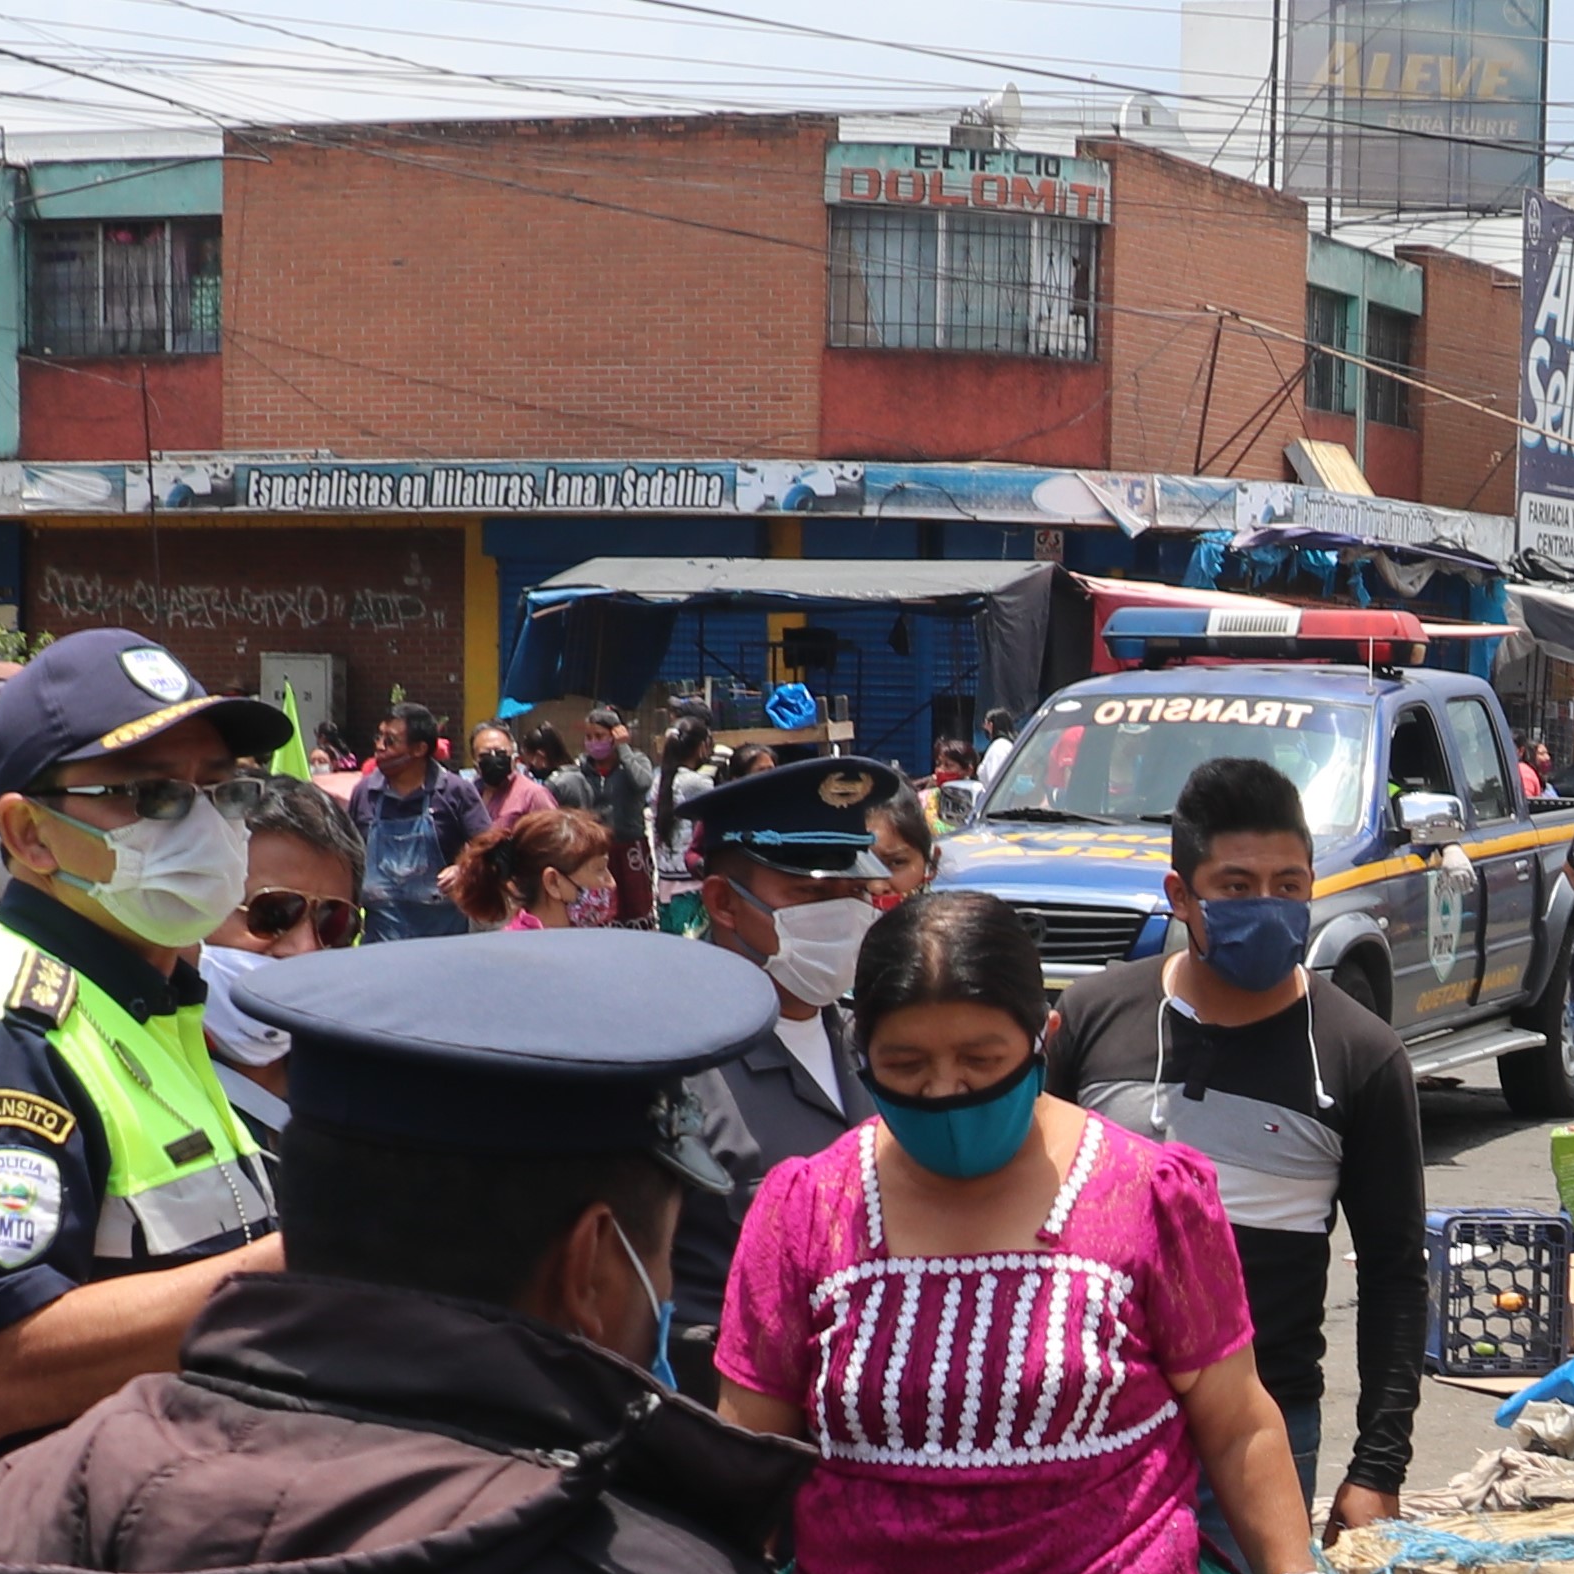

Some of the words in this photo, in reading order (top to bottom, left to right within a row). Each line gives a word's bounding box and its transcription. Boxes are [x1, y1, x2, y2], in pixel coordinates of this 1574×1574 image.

[1305, 41, 1514, 101] ALEVE
[1386, 113, 1446, 134] EXTRA
[1452, 116, 1518, 137] FUERTE
[840, 167, 1105, 221] DOLOMITI
[248, 468, 394, 508] Especialistas
[399, 473, 427, 507] en
[432, 468, 540, 510] Hilaturas,
[544, 467, 598, 507] Lana
[603, 474, 618, 510] y
[621, 467, 723, 508] Sedalina
[1528, 500, 1569, 528] FARMACIA
